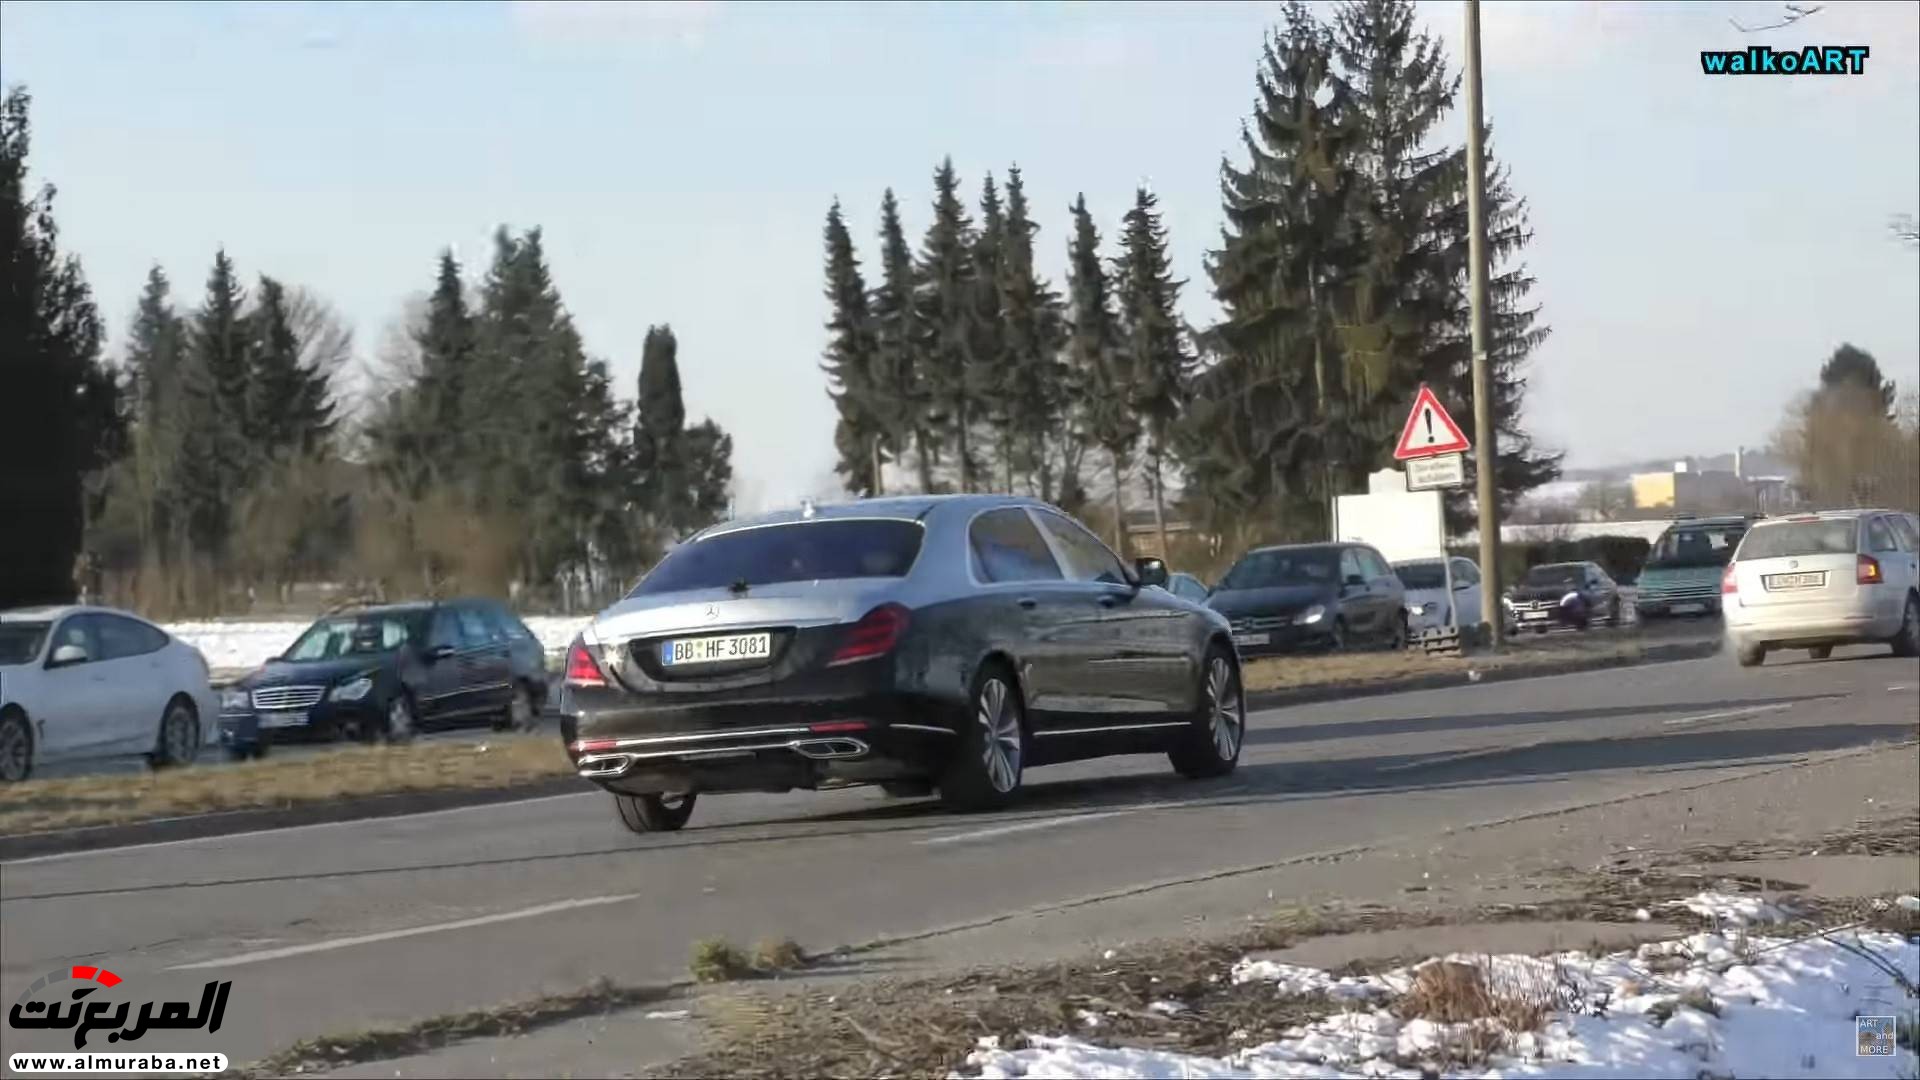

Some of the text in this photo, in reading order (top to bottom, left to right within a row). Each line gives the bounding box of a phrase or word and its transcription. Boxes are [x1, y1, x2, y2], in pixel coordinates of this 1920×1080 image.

[675, 636, 767, 661] BB HF 3081
